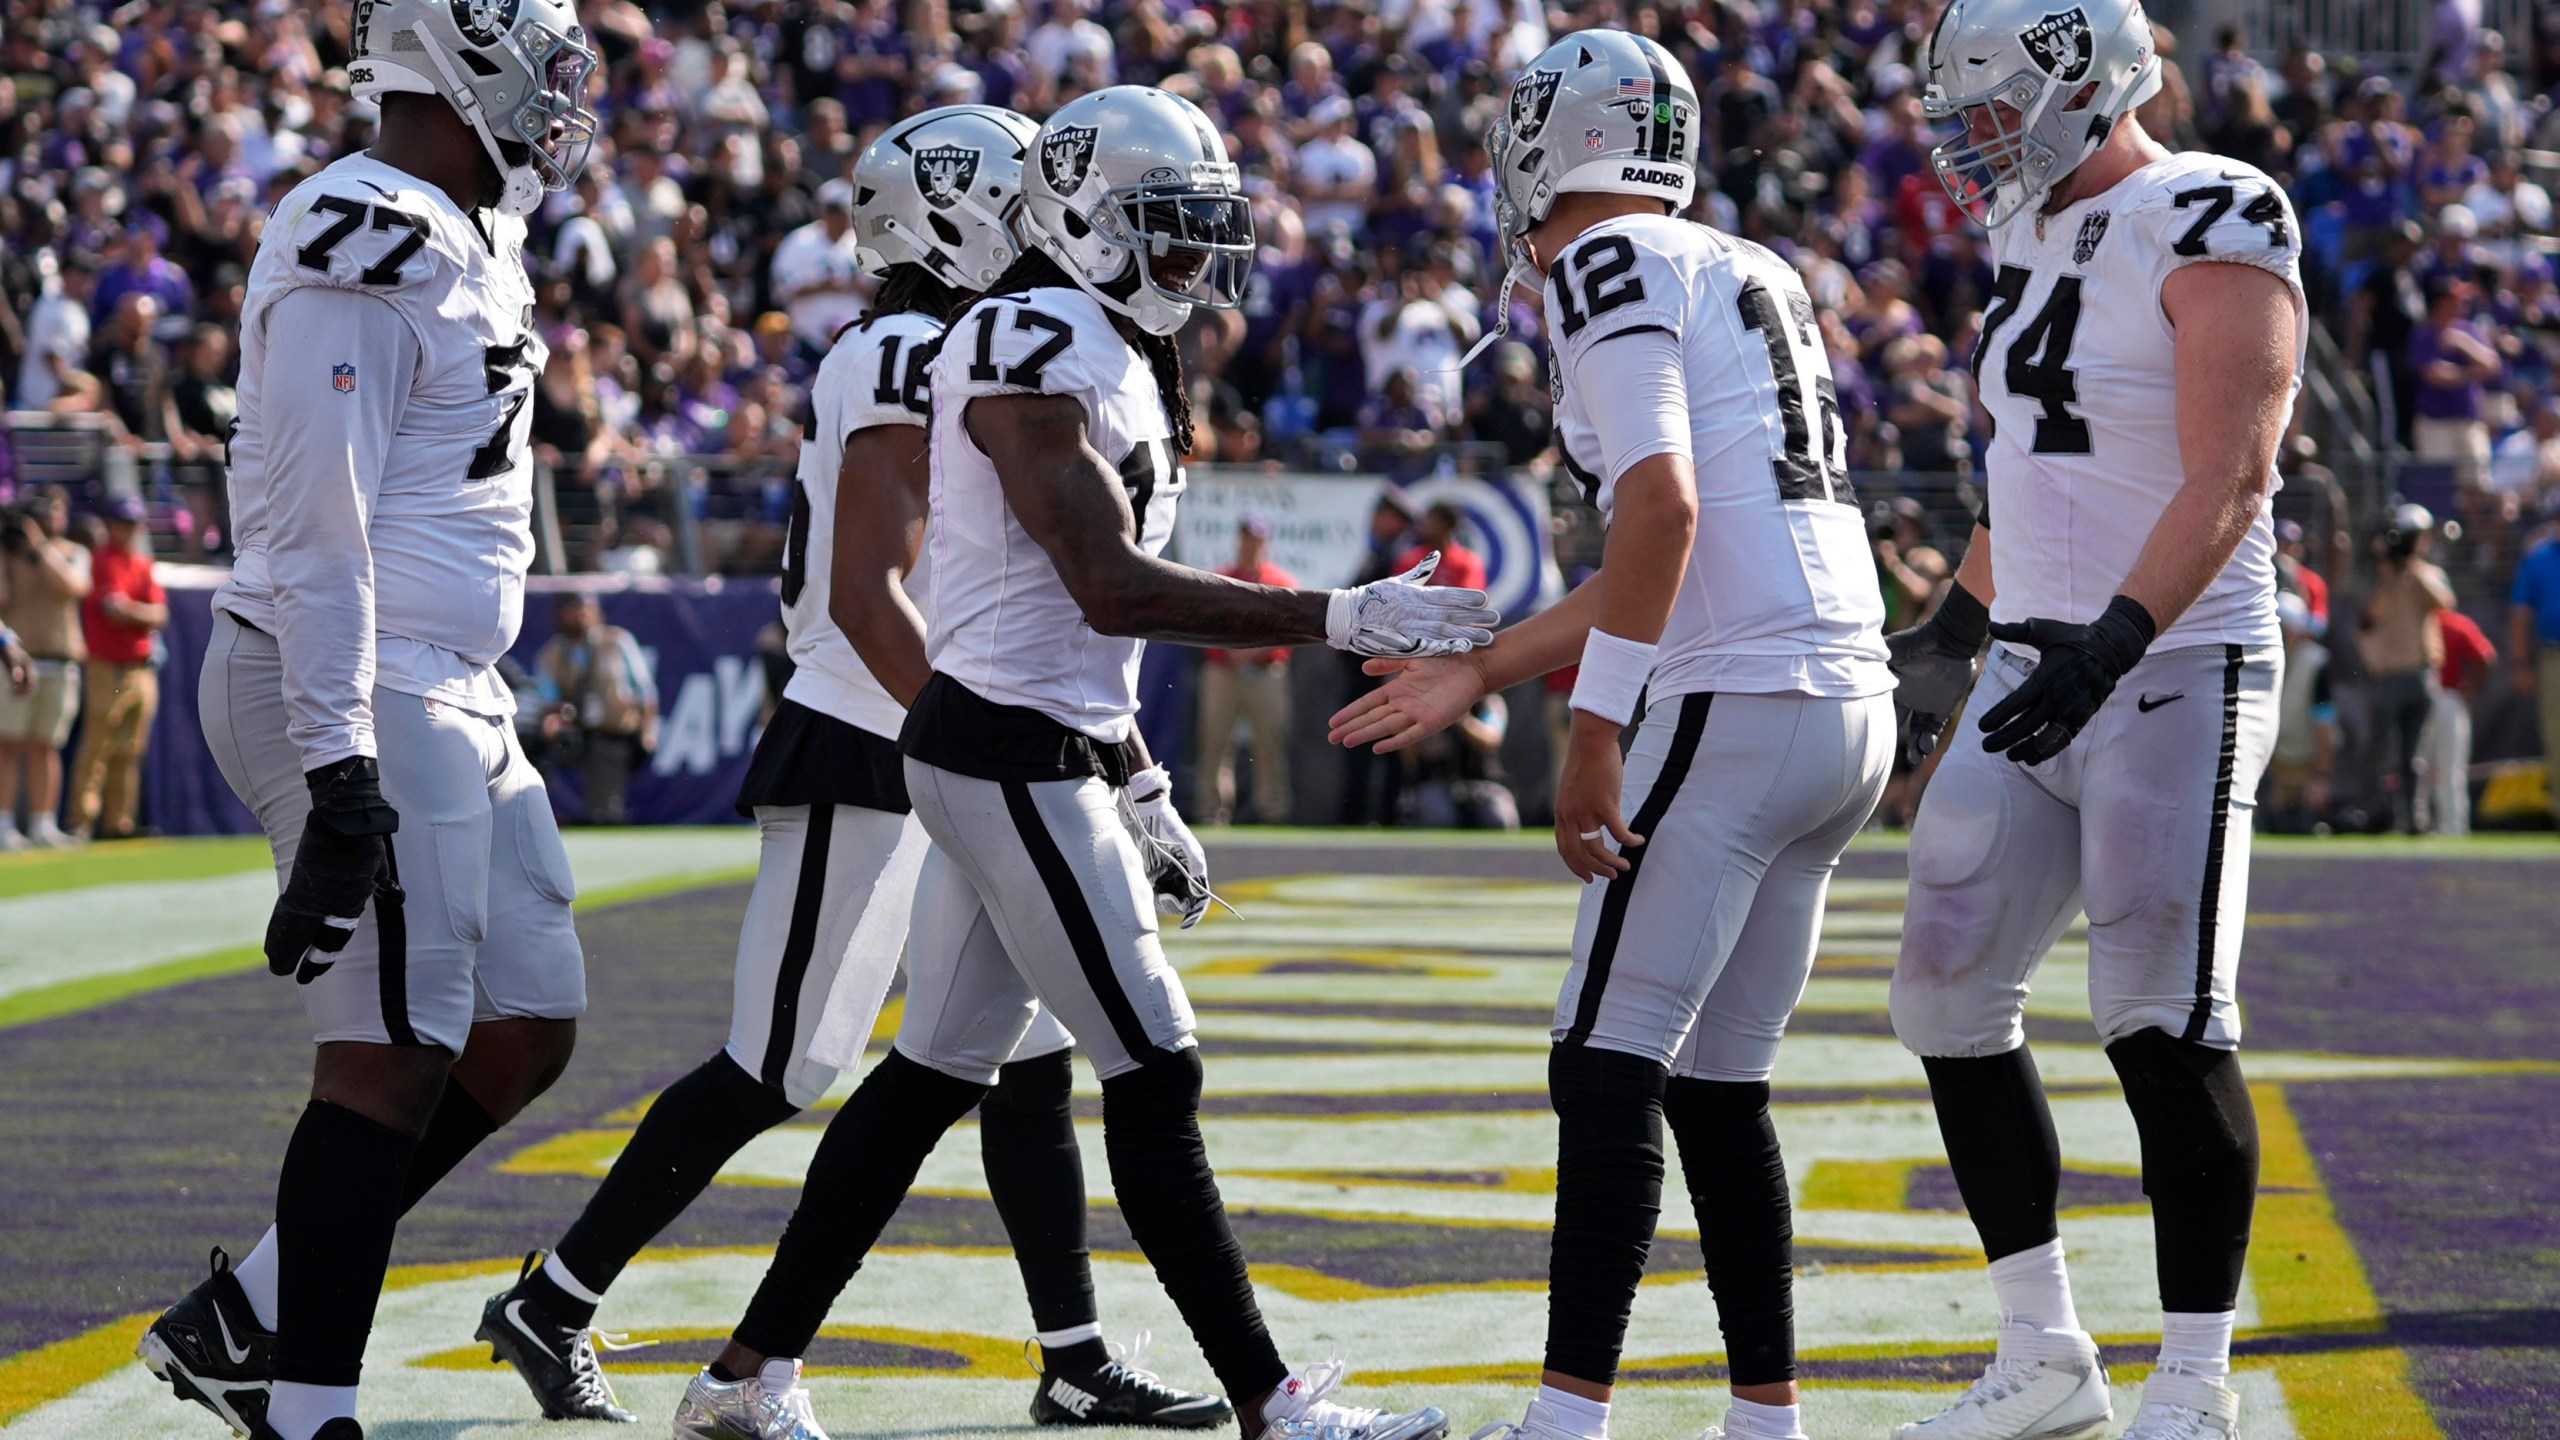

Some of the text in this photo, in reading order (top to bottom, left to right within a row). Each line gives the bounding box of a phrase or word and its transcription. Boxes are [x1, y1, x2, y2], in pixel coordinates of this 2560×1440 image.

[2025, 10, 2079, 42] RAIDERS
[1516, 72, 1556, 90] RAIDERS
[920, 150, 974, 160] RAIDERS
[1046, 129, 1092, 146] RAIDERS
[1621, 166, 1685, 190] RAIDERS
[296, 194, 429, 286] 77
[2170, 185, 2291, 256] 74
[1545, 234, 1646, 339] 12
[967, 307, 1075, 389] 17
[1971, 263, 2096, 457] 74
[335, 374, 356, 389] NFL
[1736, 274, 1861, 508] 12
[1046, 1376, 1100, 1420] NIKE
